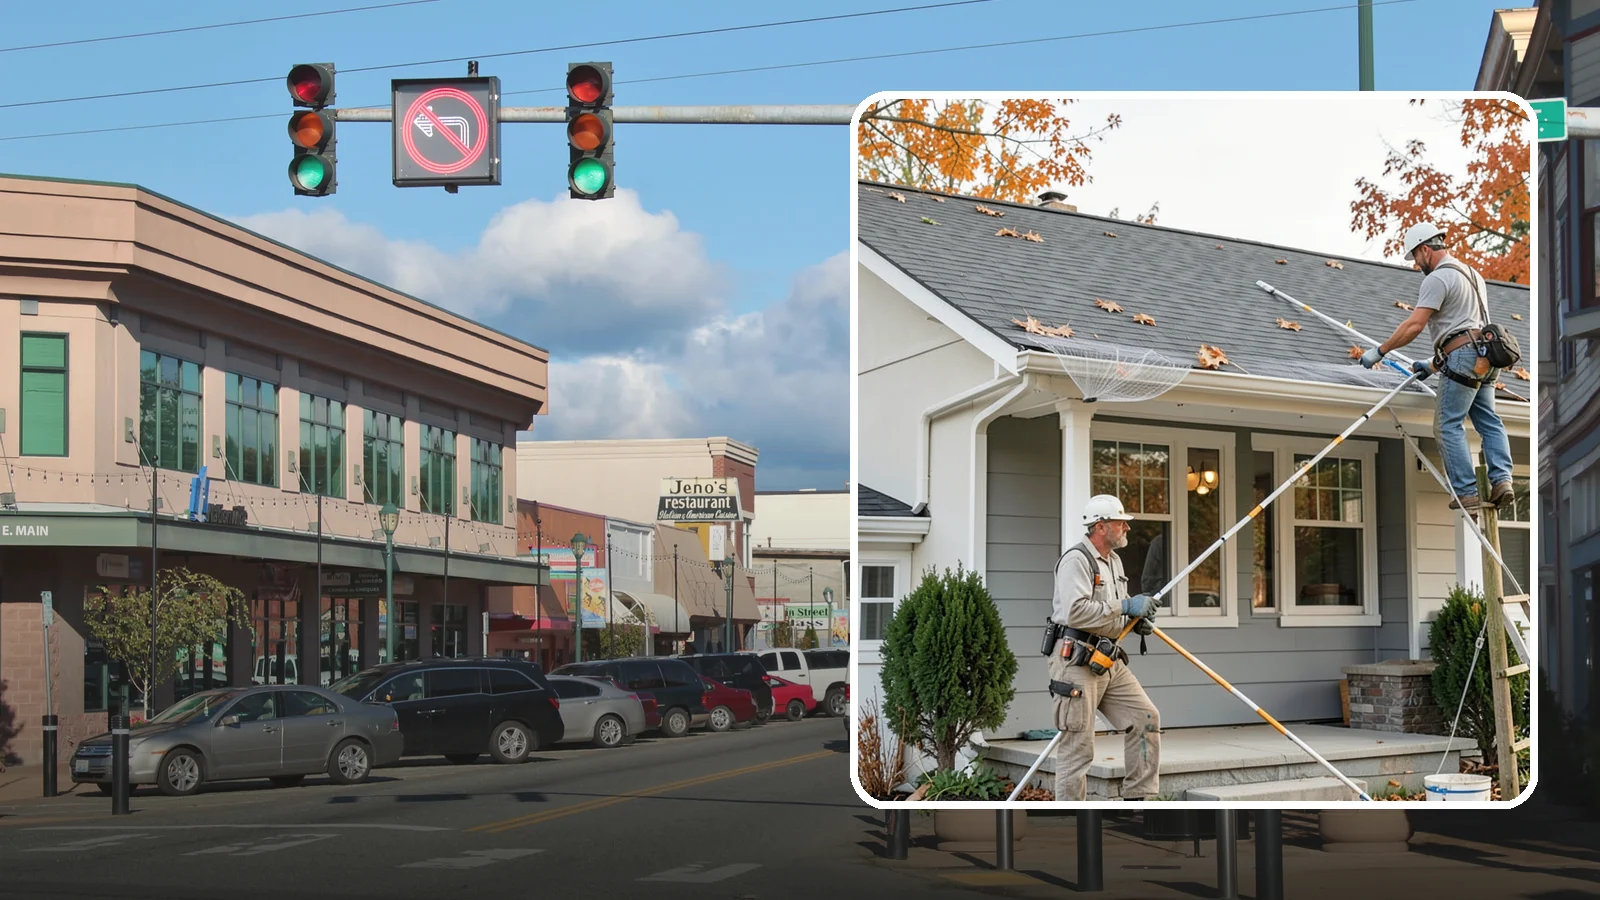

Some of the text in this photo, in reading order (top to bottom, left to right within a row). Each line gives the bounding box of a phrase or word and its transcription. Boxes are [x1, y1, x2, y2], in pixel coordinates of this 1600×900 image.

[669, 480, 728, 494] Jeno's
[665, 496, 731, 509] restaurant
[685, 509, 715, 519] American
[715, 509, 738, 519] Cuisine
[2, 525, 49, 536] E. MAIN
[797, 607, 828, 617] Street
